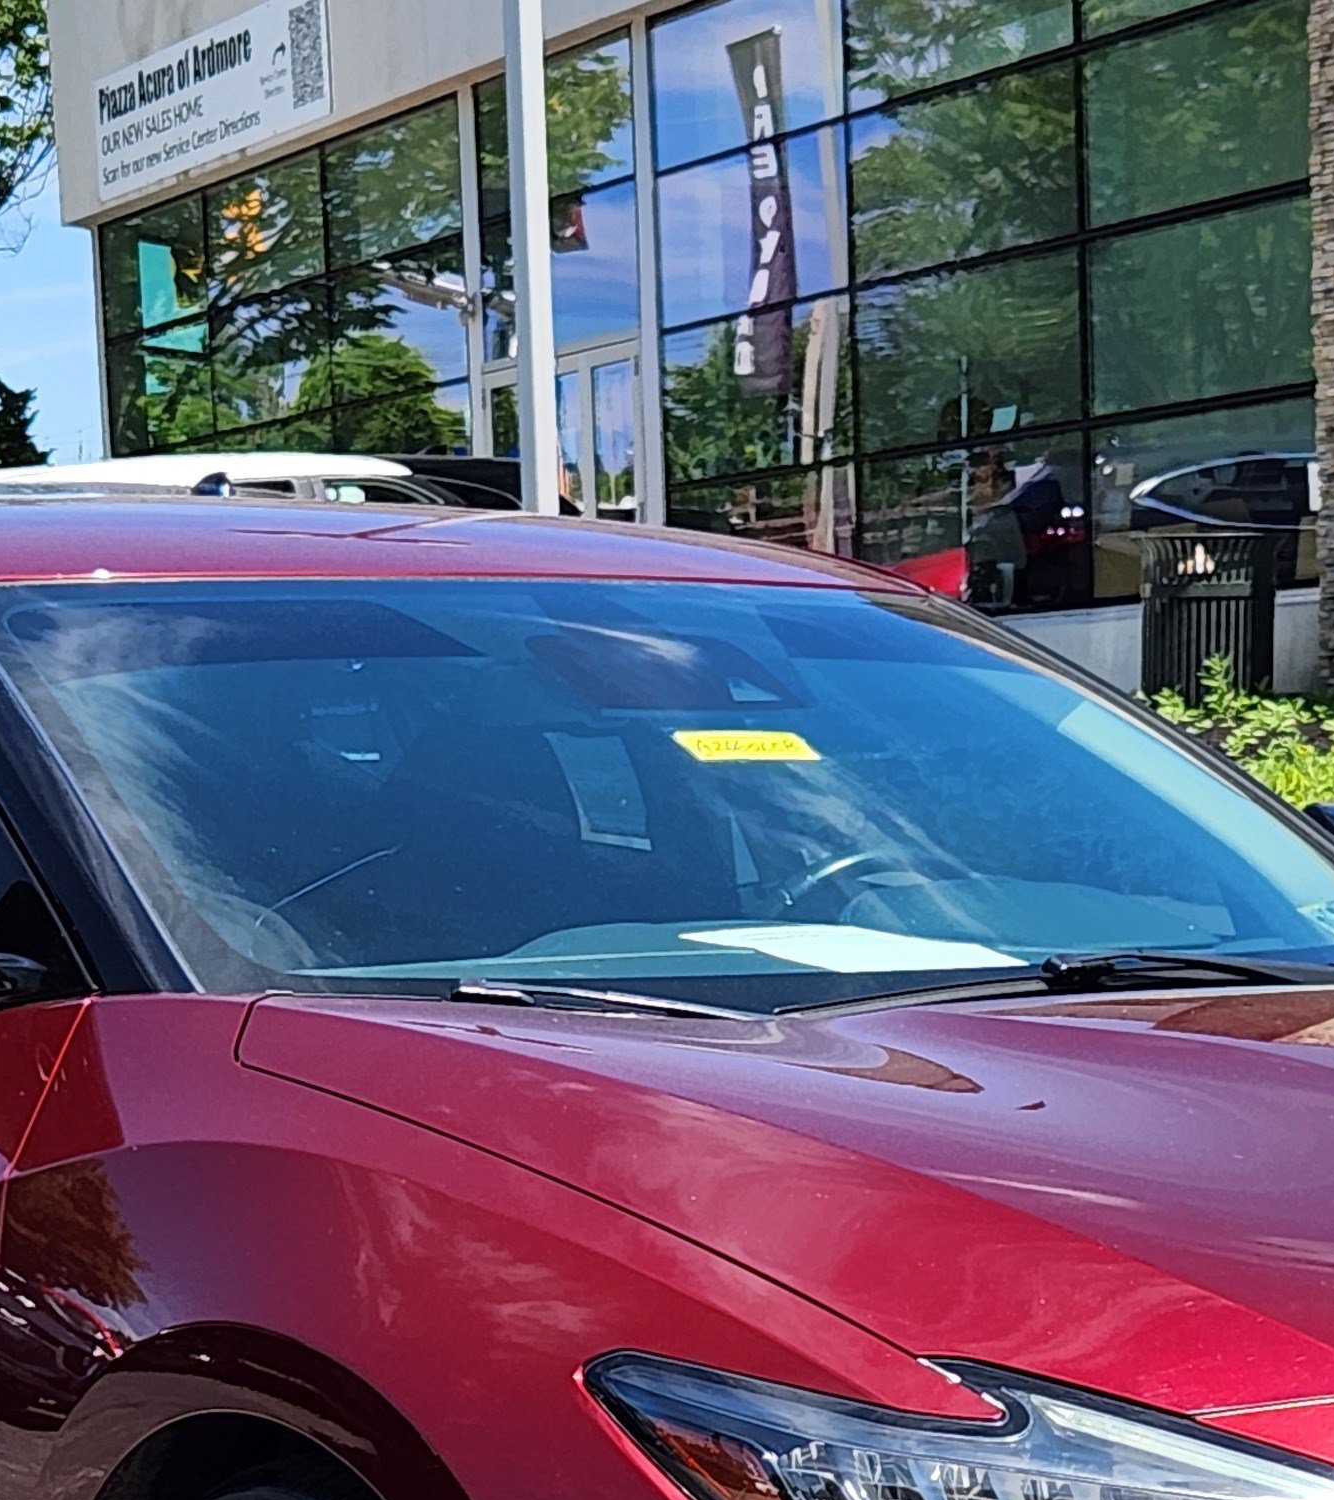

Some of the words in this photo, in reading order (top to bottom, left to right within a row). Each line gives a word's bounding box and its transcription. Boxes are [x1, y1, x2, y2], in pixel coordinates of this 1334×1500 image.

[98, 81, 137, 125] Piazza
[138, 64, 175, 108] Acura
[177, 49, 190, 91] of
[193, 29, 252, 85] Ardmore
[101, 131, 121, 156] OUR
[122, 119, 144, 148] NEW
[145, 109, 173, 139] SALES
[173, 95, 204, 127] HOME
[102, 164, 120, 185] Scan
[163, 137, 190, 162] Service
[191, 127, 218, 151] Center
[219, 110, 261, 140] Directions
